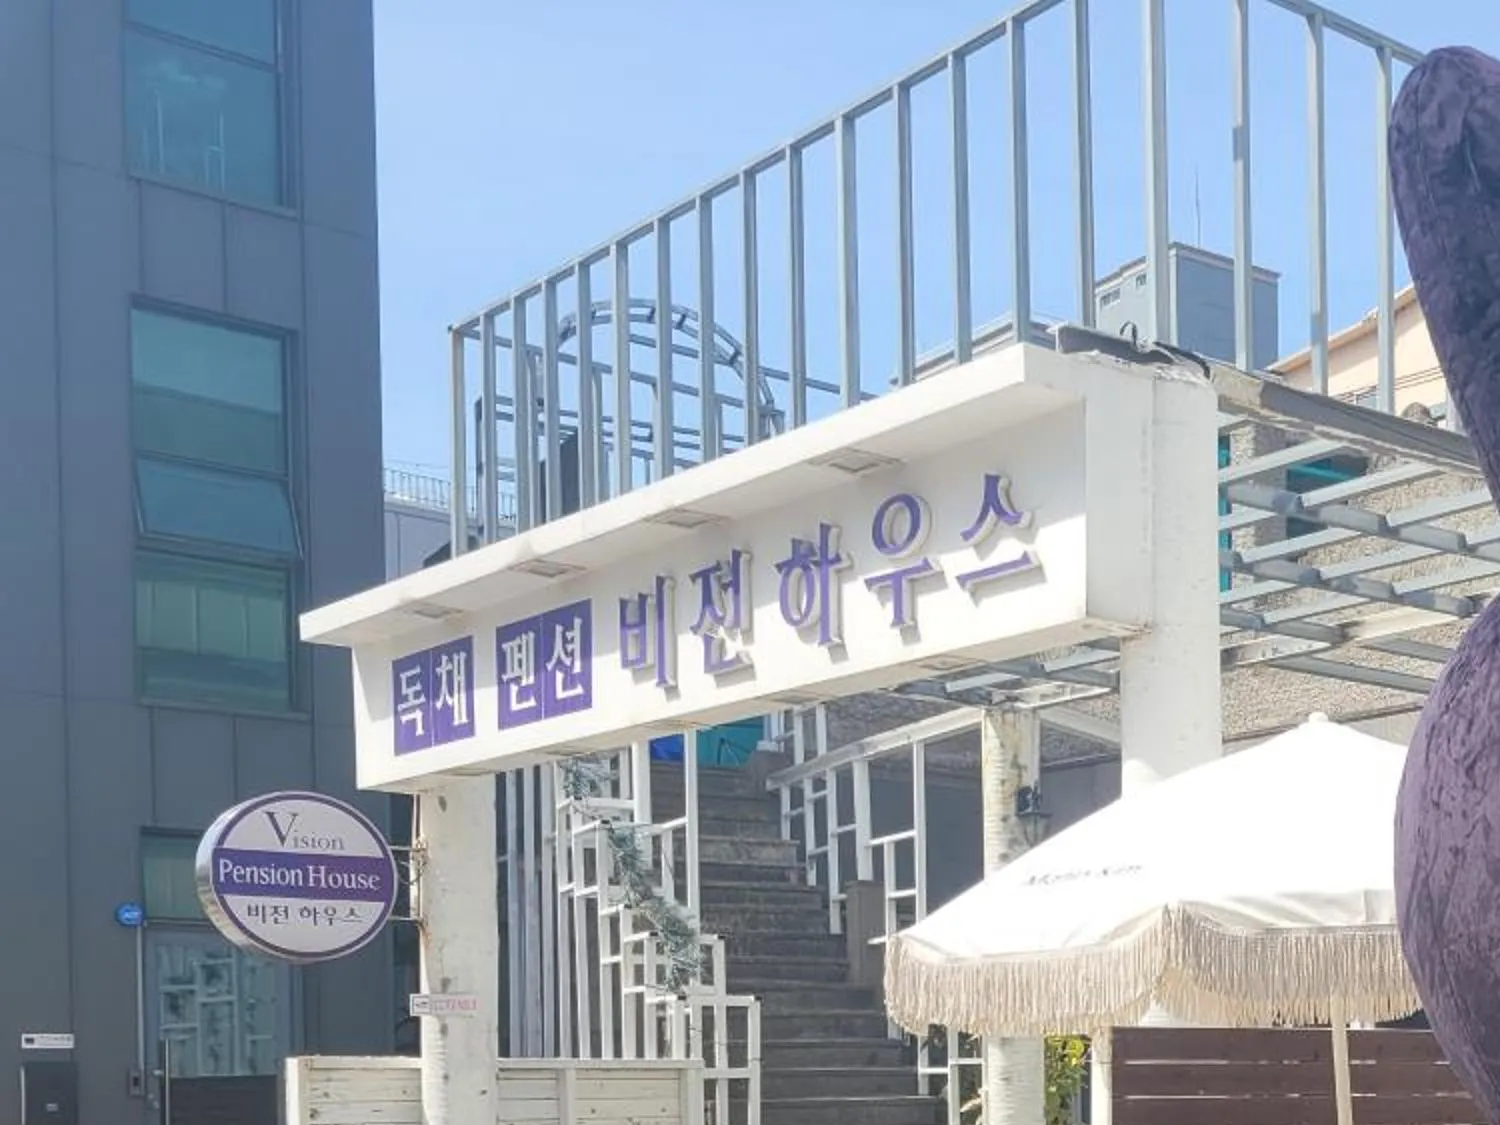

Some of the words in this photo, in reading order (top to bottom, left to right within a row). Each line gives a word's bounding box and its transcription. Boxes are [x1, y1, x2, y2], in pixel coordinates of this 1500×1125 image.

[397, 651, 469, 737] 독채
[501, 617, 585, 712] 펜션
[618, 473, 1041, 689] 비전하우스
[263, 811, 346, 851] Vision
[218, 858, 304, 888] Pension
[308, 864, 382, 891] House
[247, 904, 290, 925] 비전
[299, 905, 363, 927] 하우스
